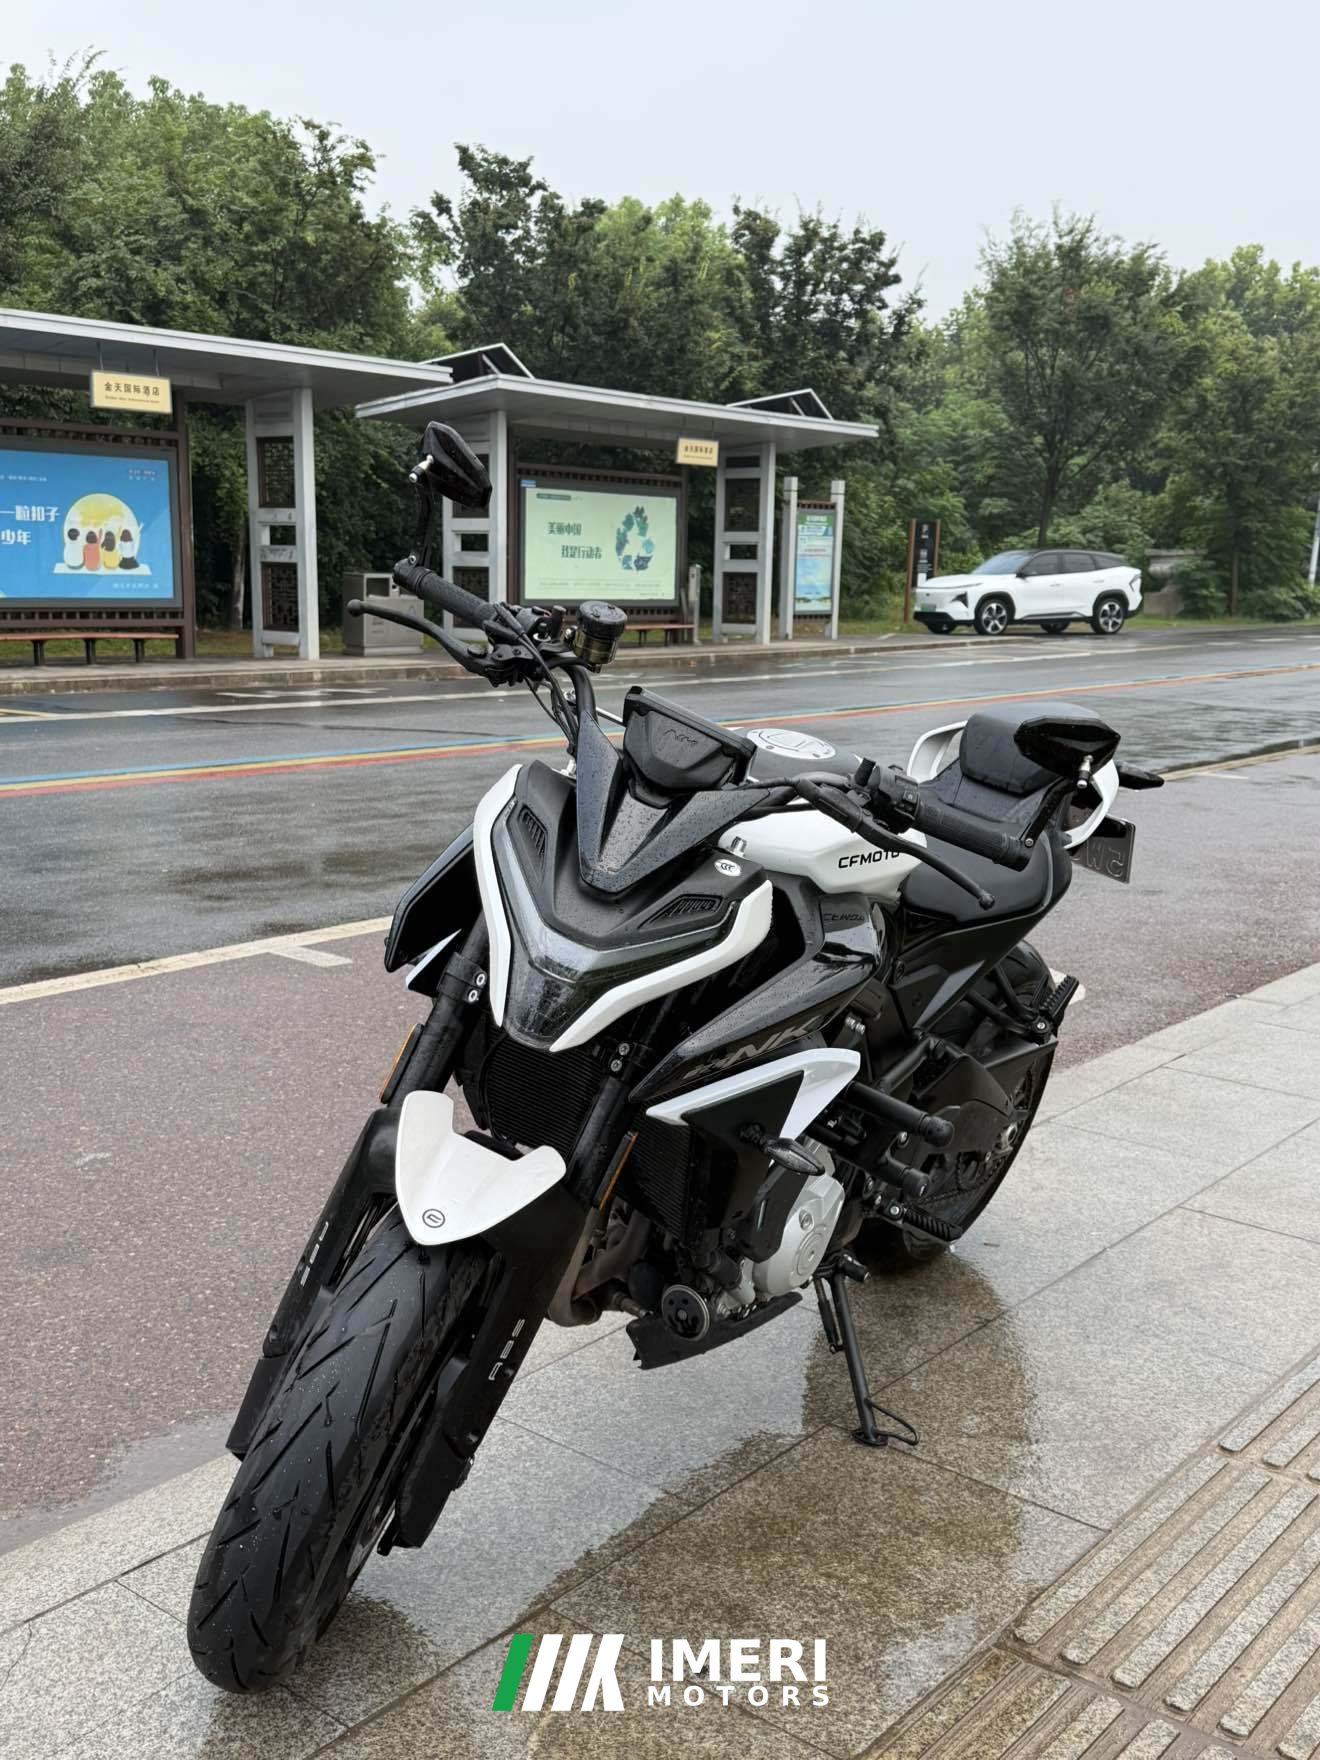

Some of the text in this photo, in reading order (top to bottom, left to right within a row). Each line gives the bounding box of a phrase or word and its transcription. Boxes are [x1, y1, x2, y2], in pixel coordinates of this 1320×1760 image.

[104, 381, 160, 396] 金天国际酒店
